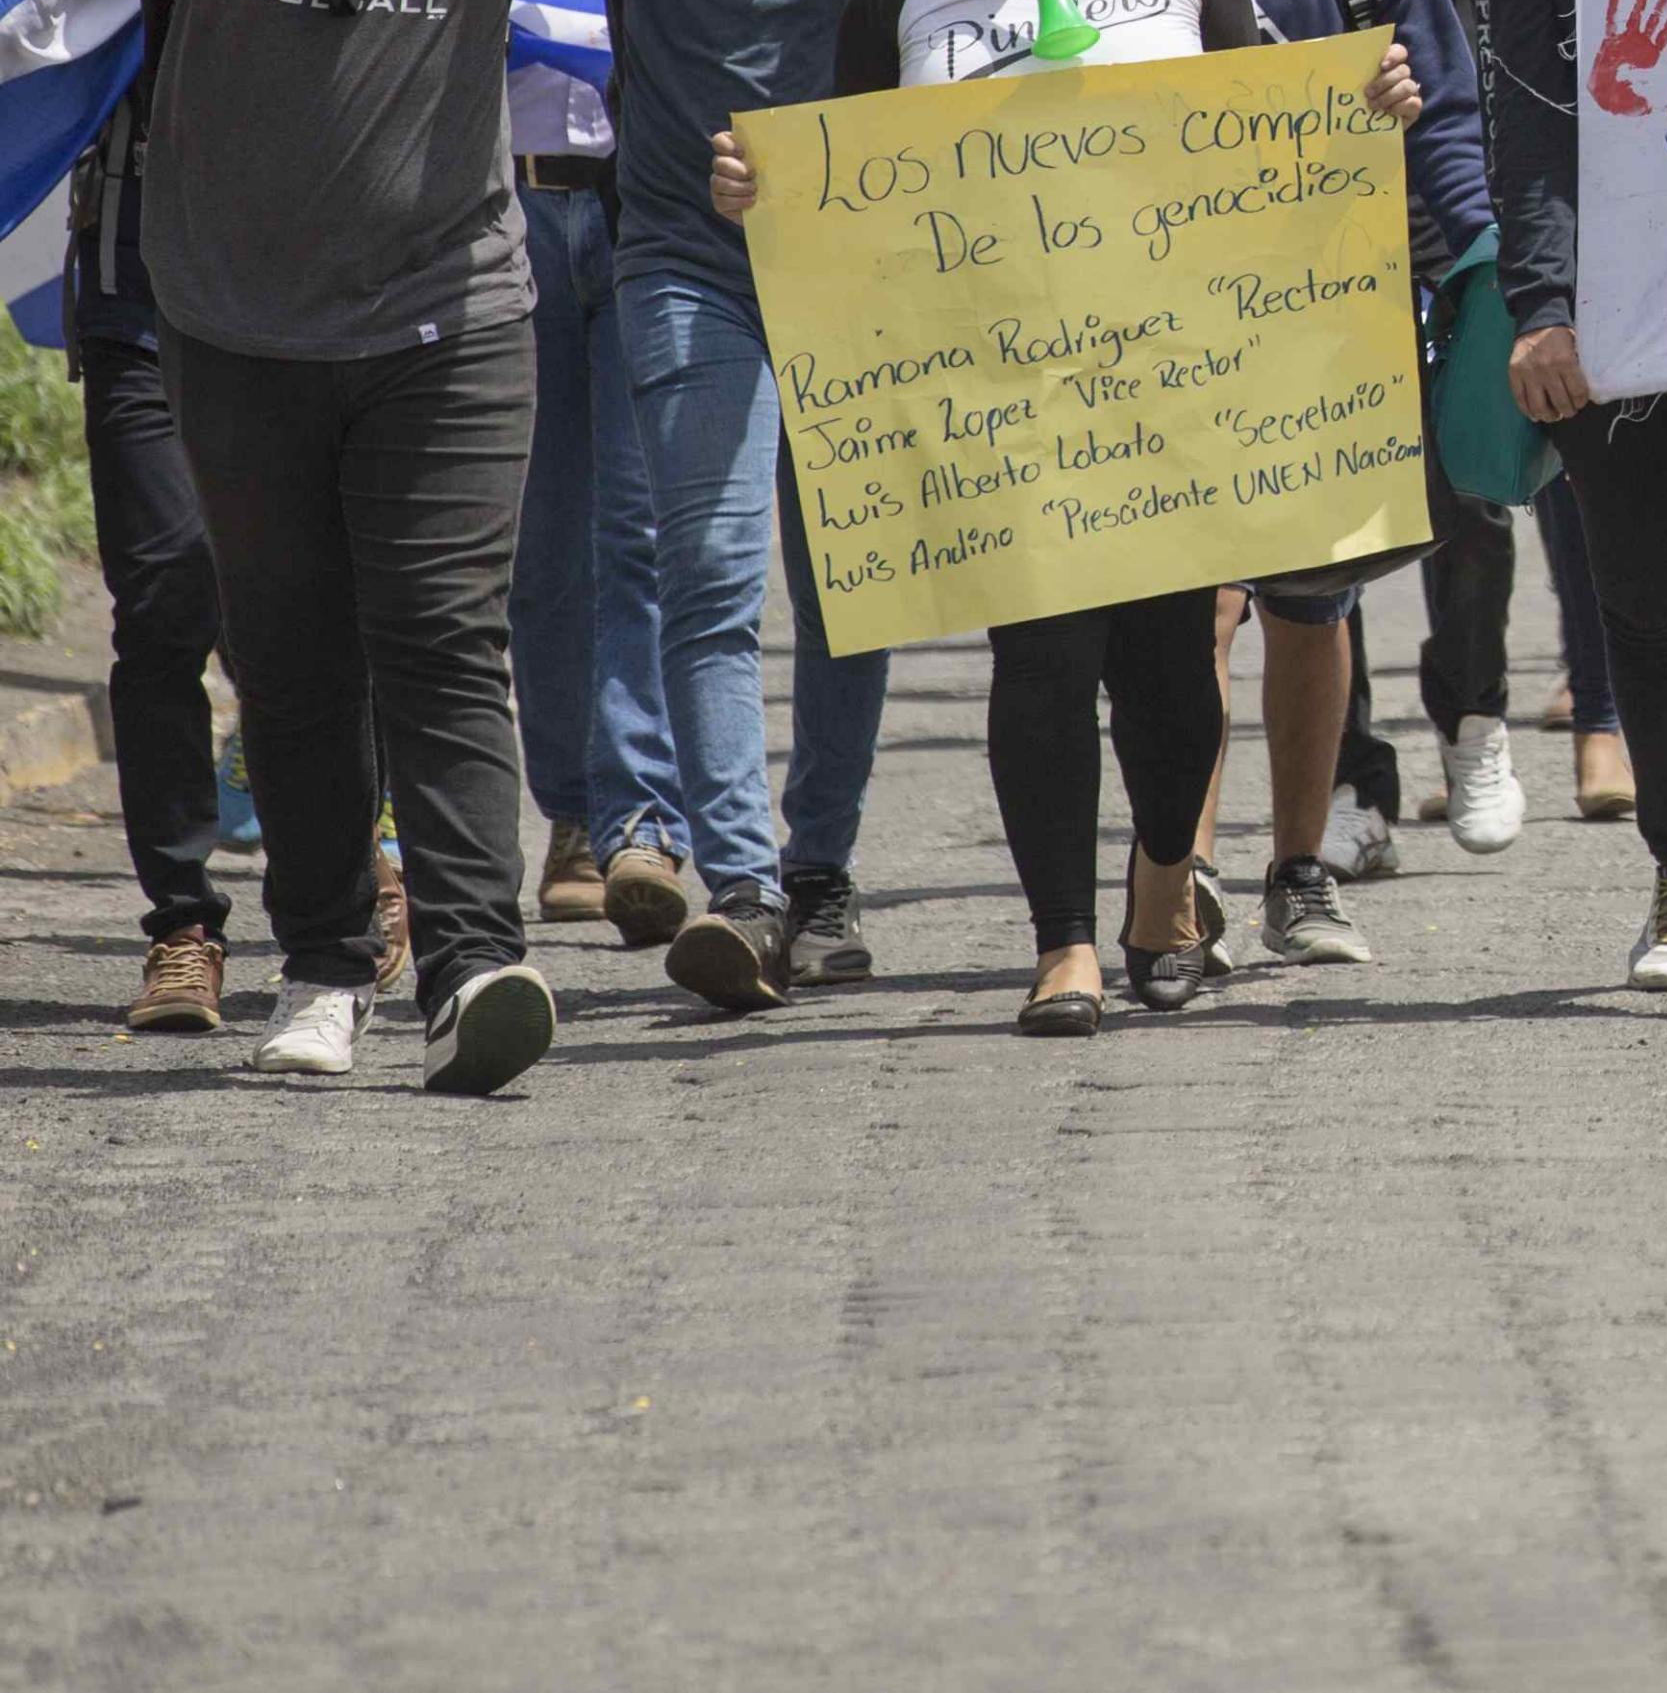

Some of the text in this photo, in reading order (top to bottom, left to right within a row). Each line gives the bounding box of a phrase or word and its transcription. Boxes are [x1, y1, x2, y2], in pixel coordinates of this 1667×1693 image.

[818, 113, 930, 211] Los
[955, 124, 1146, 179] nuevos
[914, 210, 1005, 272] De
[1032, 194, 1102, 254] los
[780, 347, 975, 413] Ramona
[988, 314, 1184, 368] Rodriguez
[799, 417, 917, 471] Jaime
[939, 397, 1038, 447] Lopez
[818, 481, 904, 531] Luis
[921, 455, 1041, 508] Alberto
[1056, 421, 1165, 470] Lobato
[825, 551, 896, 593] Luis
[911, 527, 1014, 575] Andino
[1233, 451, 1323, 506] UNEN
